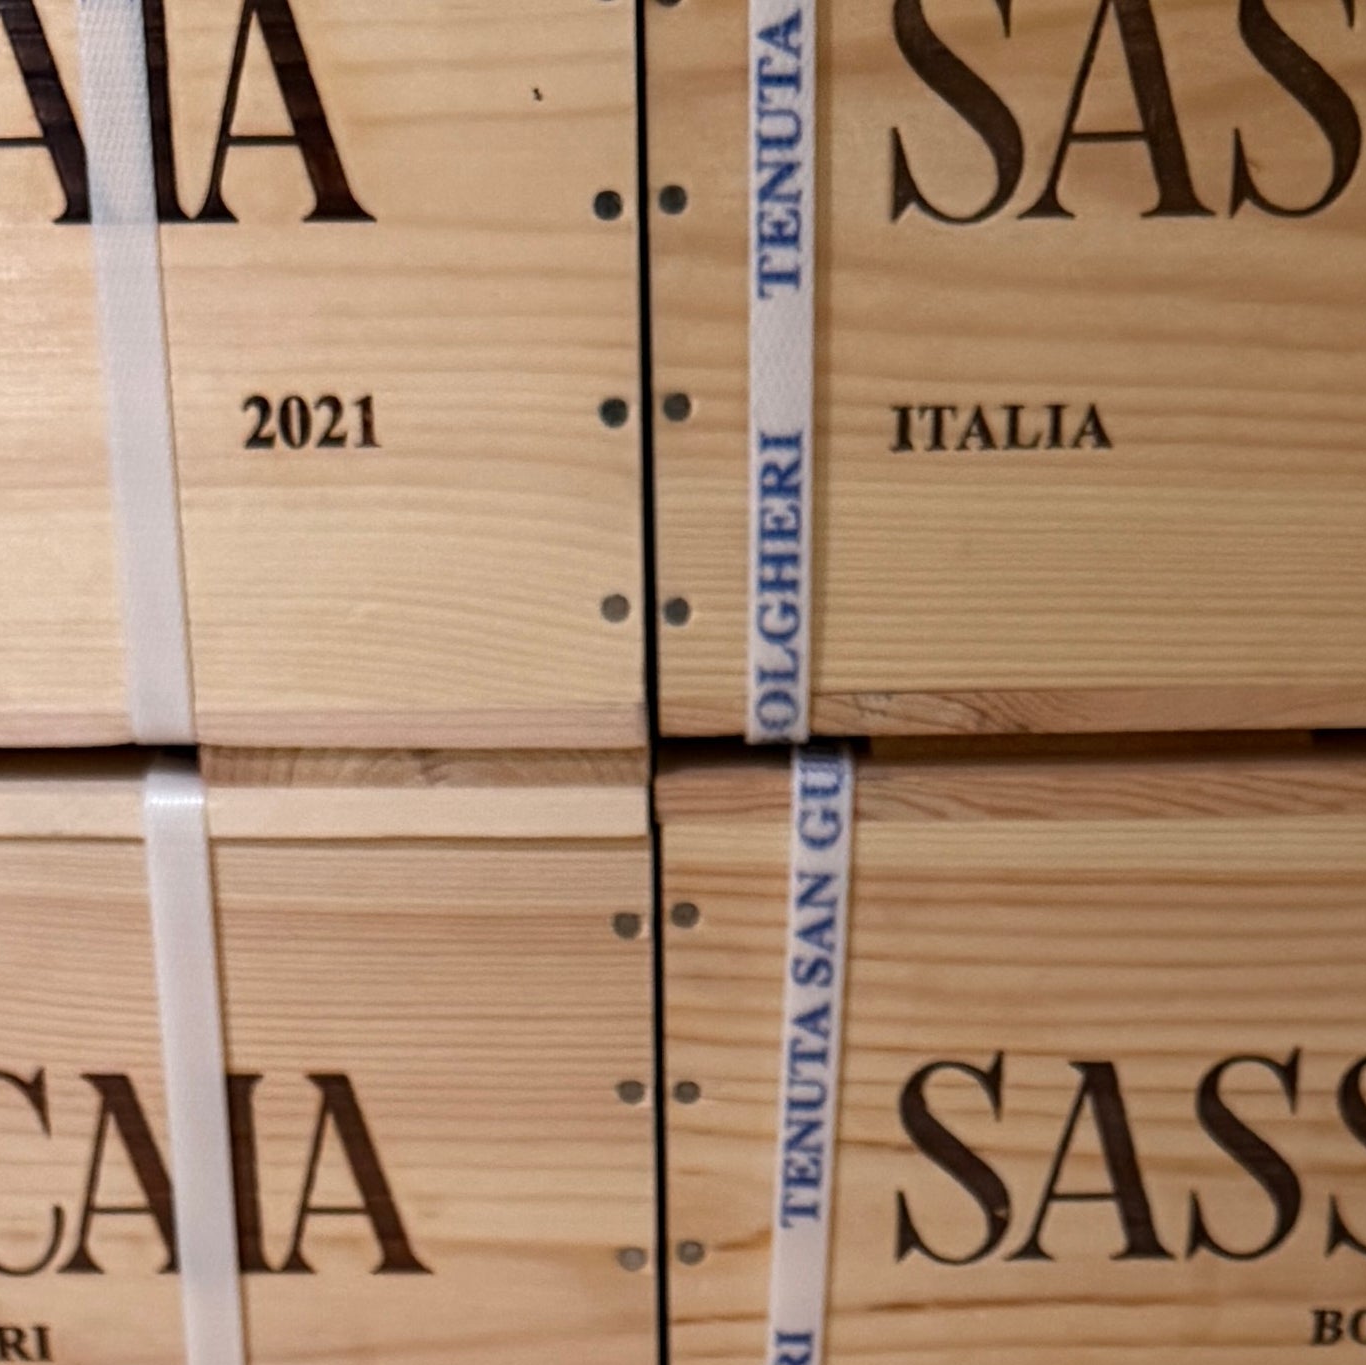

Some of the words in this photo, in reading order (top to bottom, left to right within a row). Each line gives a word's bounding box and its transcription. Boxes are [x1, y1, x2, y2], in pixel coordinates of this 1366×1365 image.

[756, 12, 804, 299] TENUTA
[242, 394, 382, 450] 2021
[888, 403, 1114, 452] ITALIA
[792, 869, 839, 990] SAN
[780, 1004, 832, 1228] TENUTA
